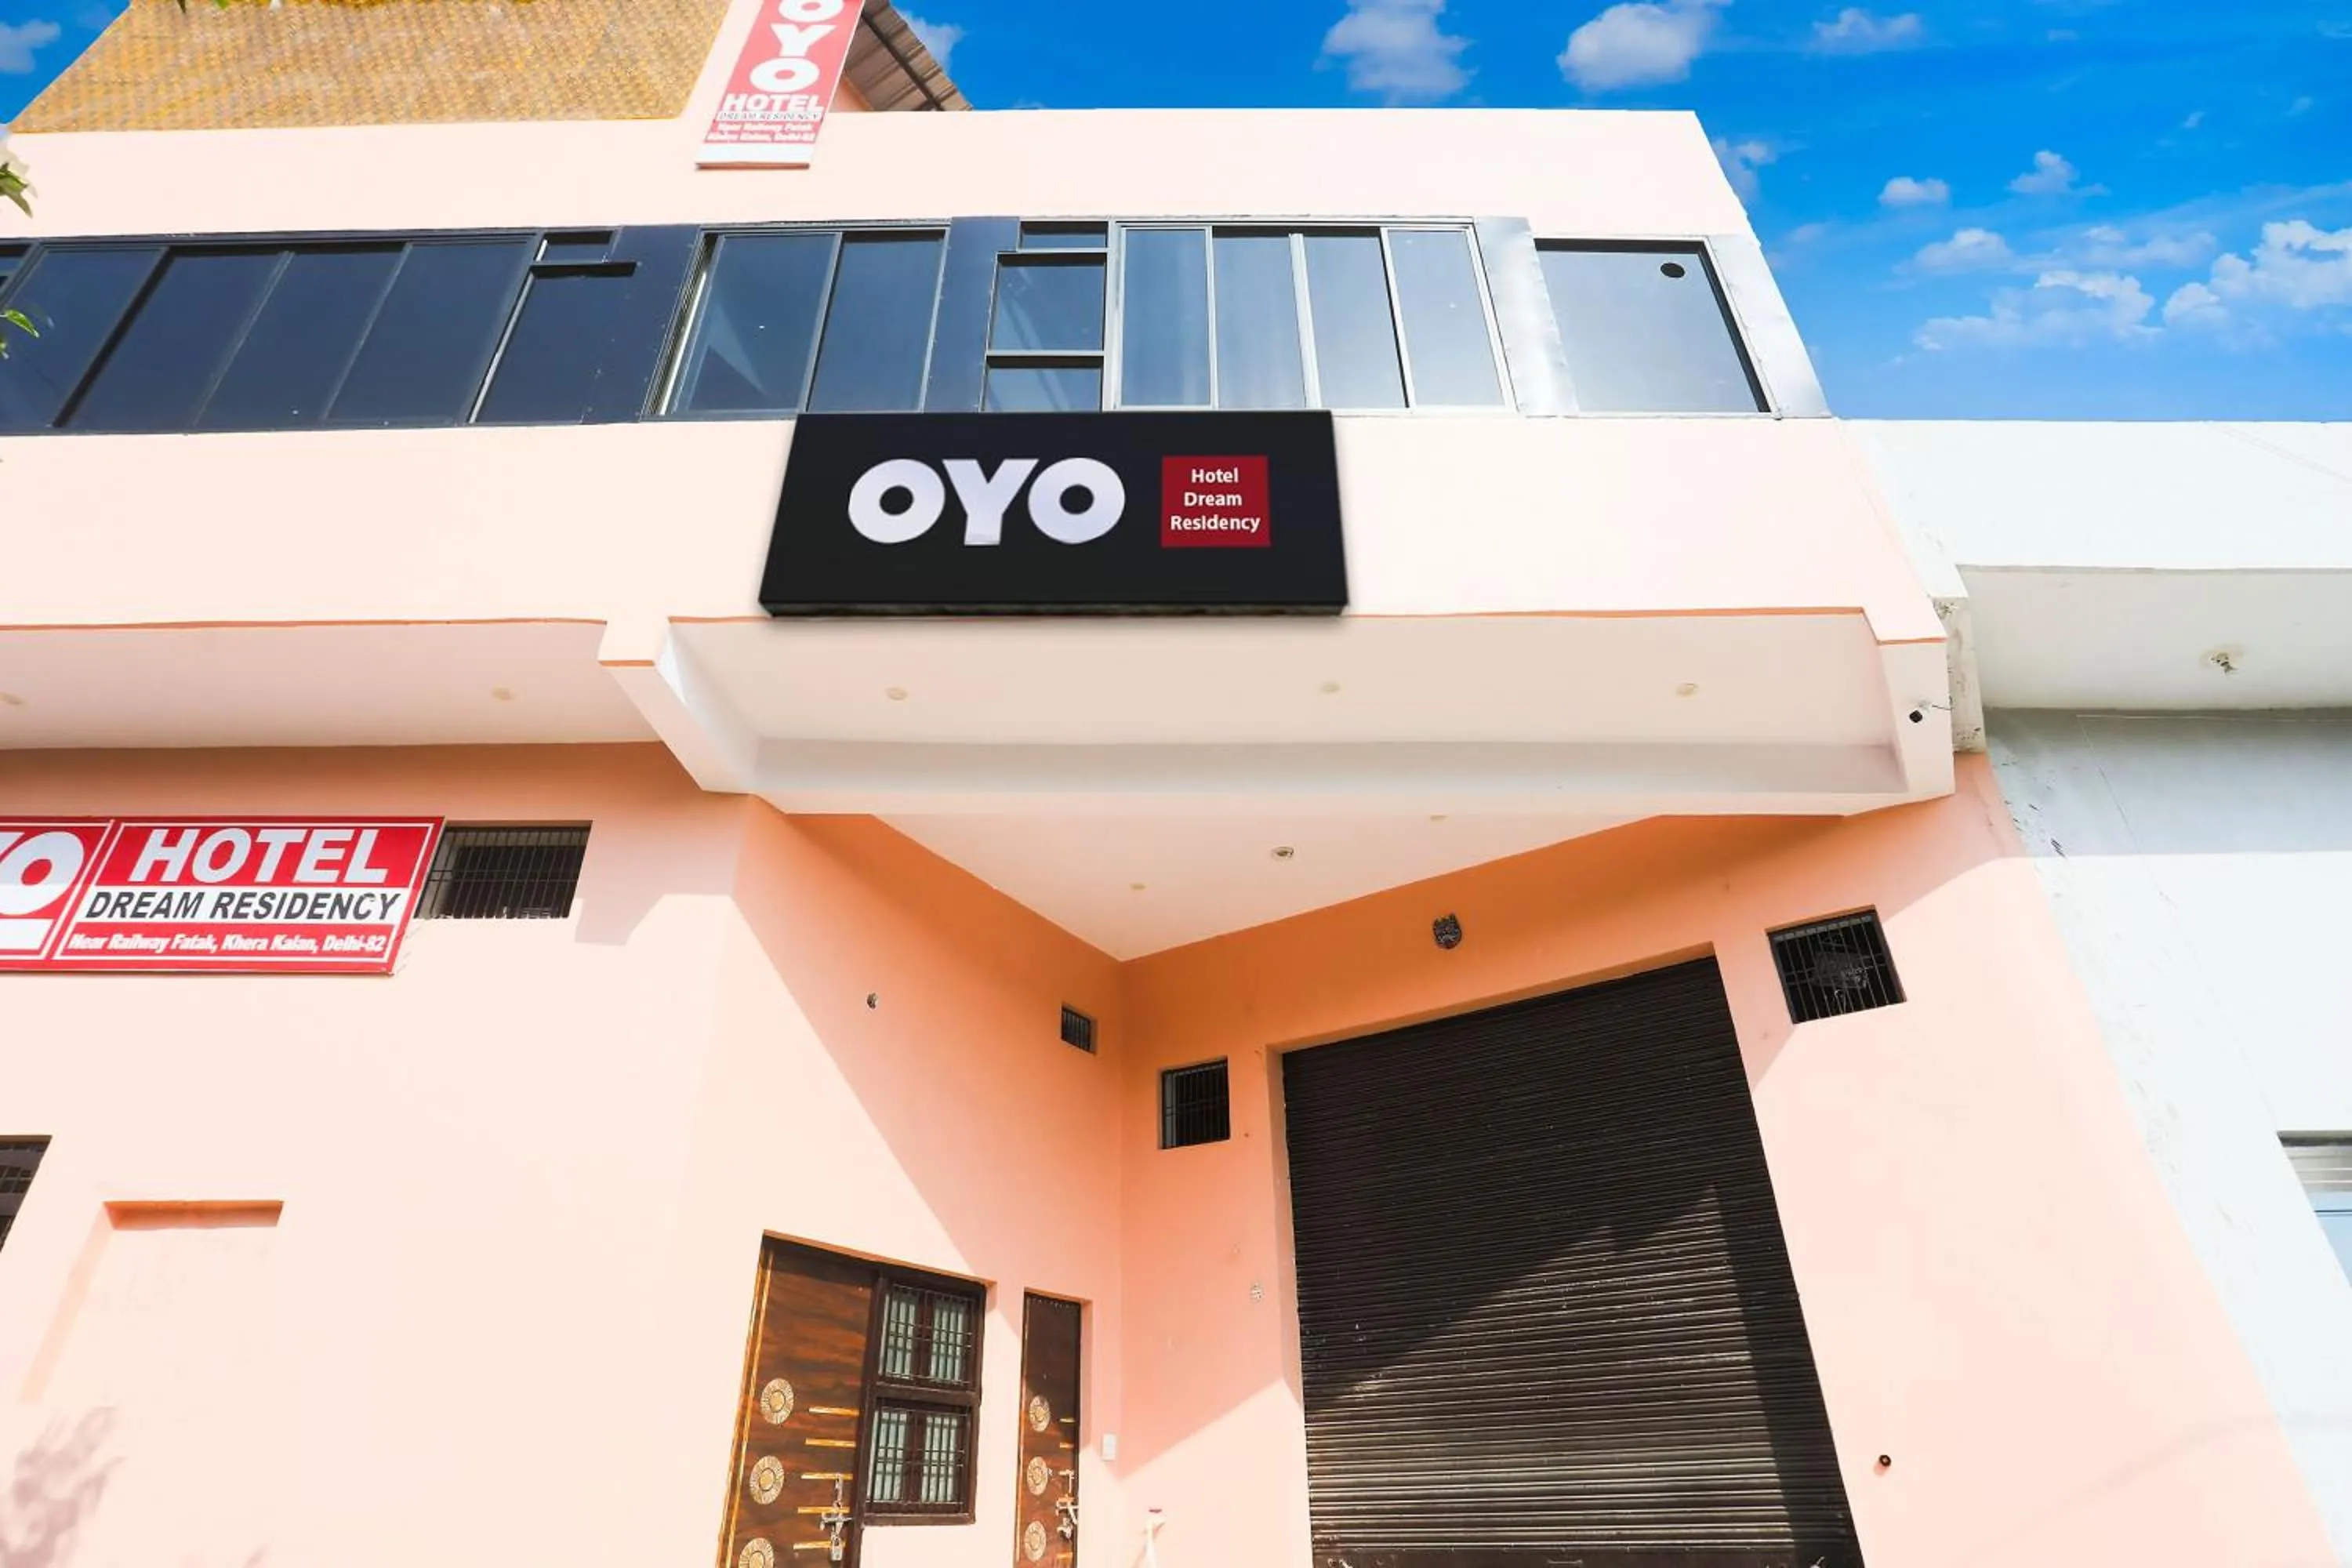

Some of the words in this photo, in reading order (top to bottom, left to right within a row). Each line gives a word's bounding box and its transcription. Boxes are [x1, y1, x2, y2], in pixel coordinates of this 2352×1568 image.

[750, 0, 844, 93] OYO
[723, 93, 824, 111] HOTEL
[1191, 467, 1239, 484] Hotel
[848, 458, 1125, 545] OYO
[1184, 492, 1243, 506] Dream
[1171, 514, 1261, 533] Residency
[128, 827, 388, 884] HOTEL
[85, 891, 205, 919] DREAM
[209, 891, 401, 920] RESIDENCY
[68, 934, 109, 949] Near
[107, 934, 172, 953] Railway
[222, 934, 269, 951] Khera
[322, 935, 388, 952] Delhi-82
